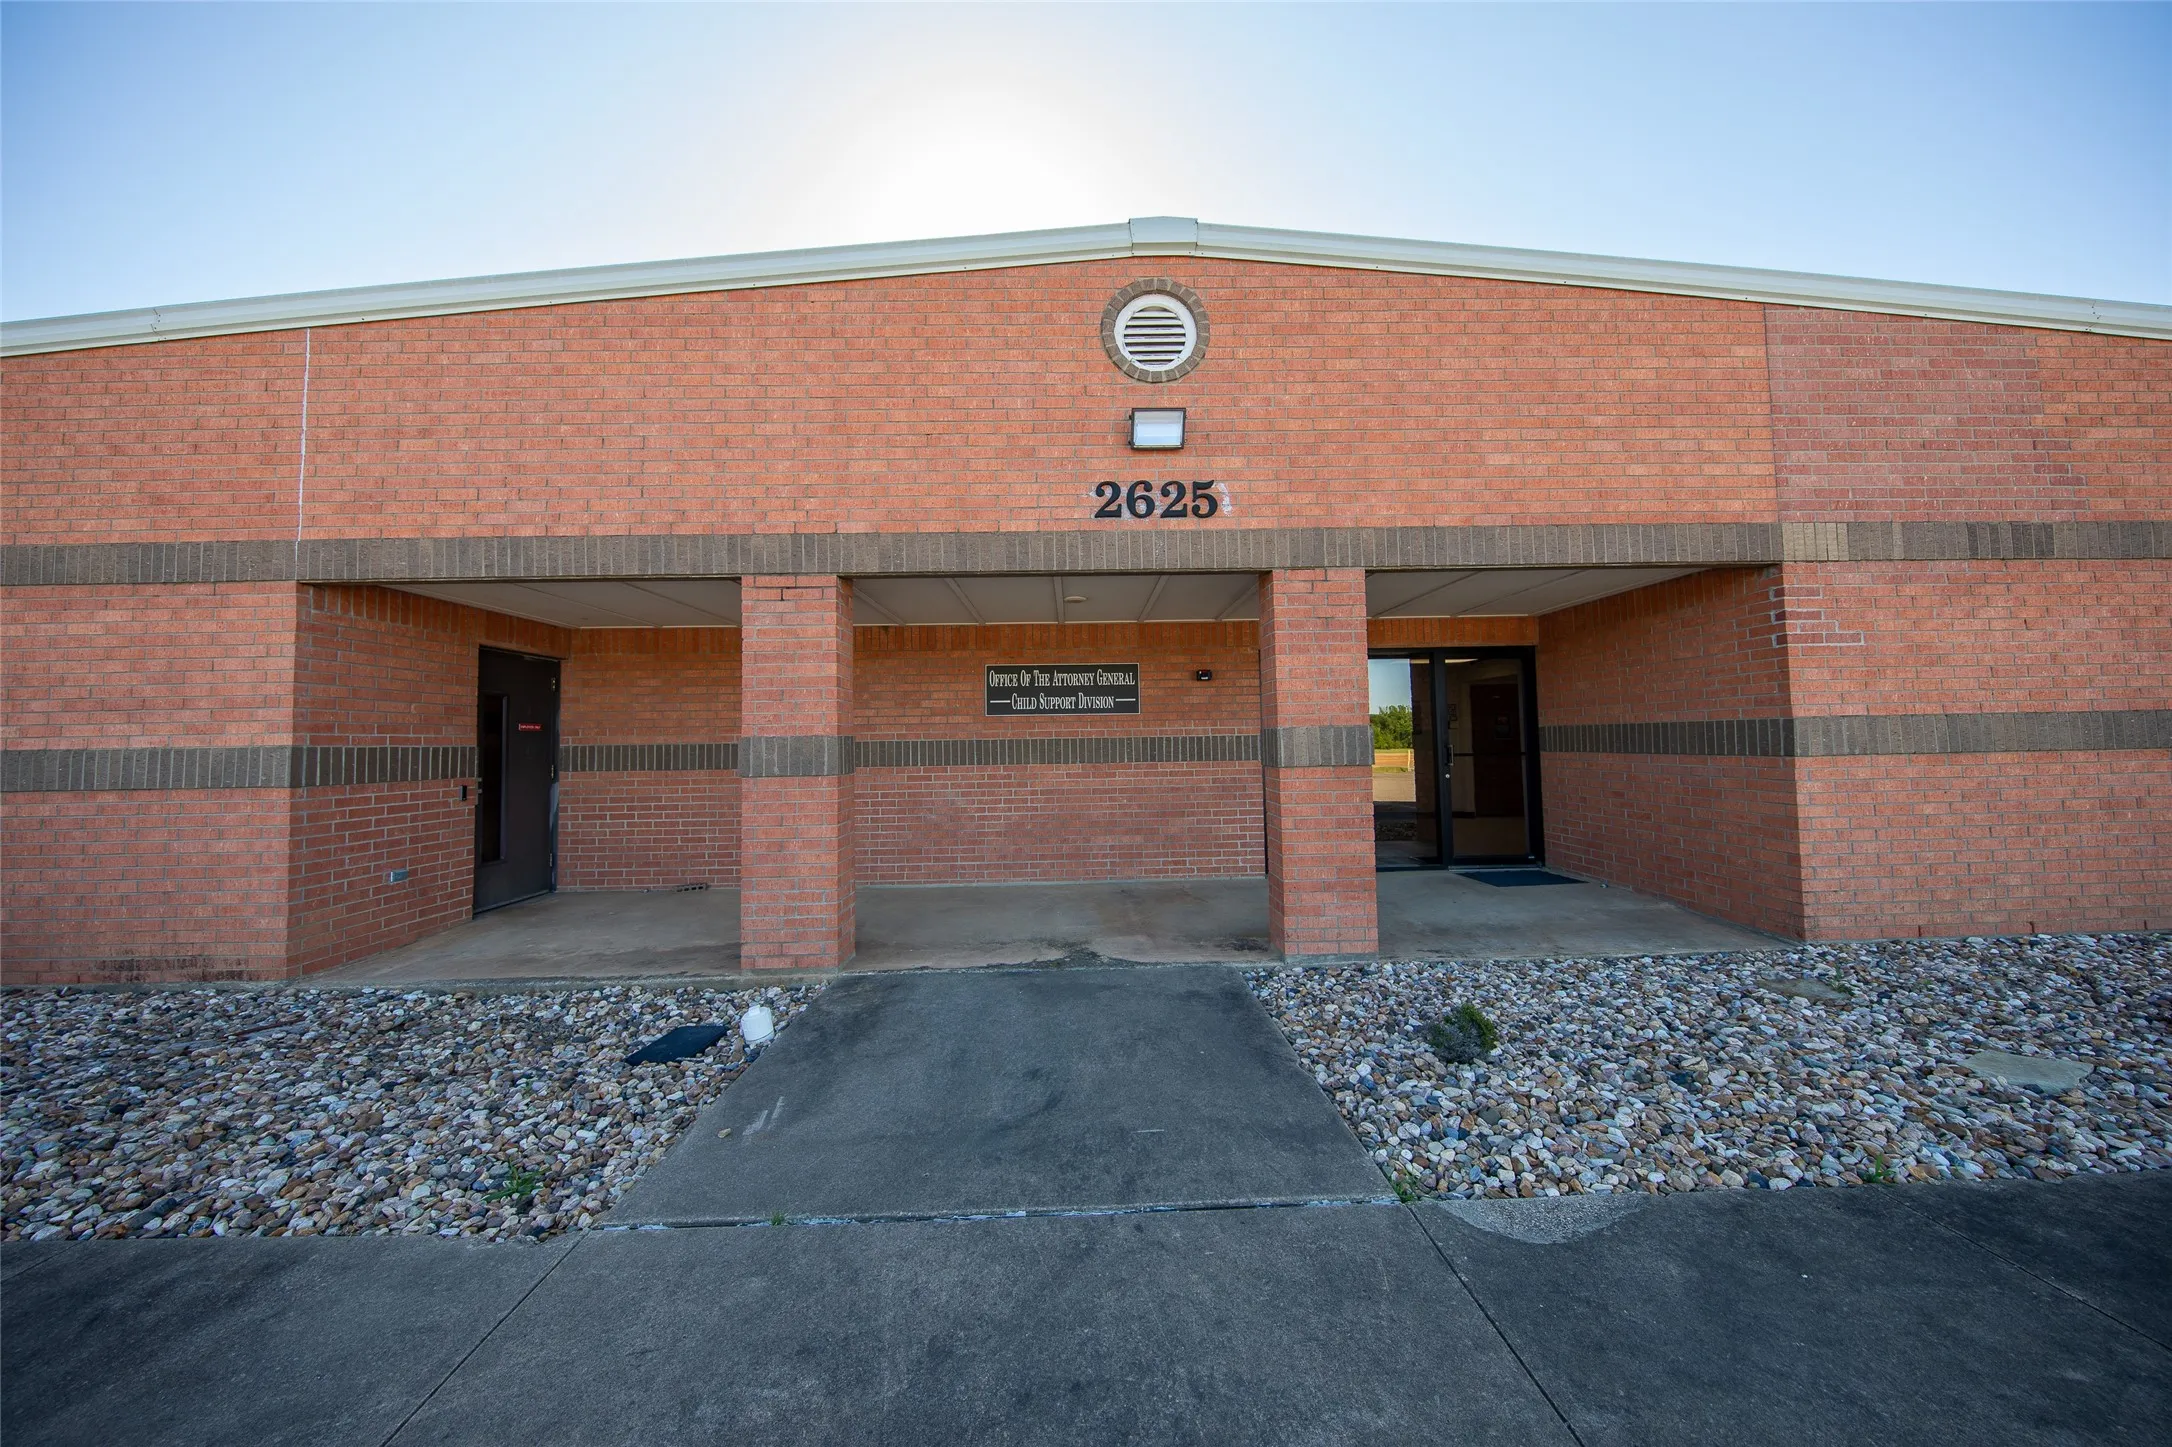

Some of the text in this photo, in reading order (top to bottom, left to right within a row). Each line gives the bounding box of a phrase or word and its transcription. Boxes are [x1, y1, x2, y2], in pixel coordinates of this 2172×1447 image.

[1094, 480, 1218, 519] 2625
[990, 669, 1135, 687] OFFICE OF THE ATTORNEY GENERAL
[1012, 692, 1114, 709] CHILD SUPPORT DIVISION
